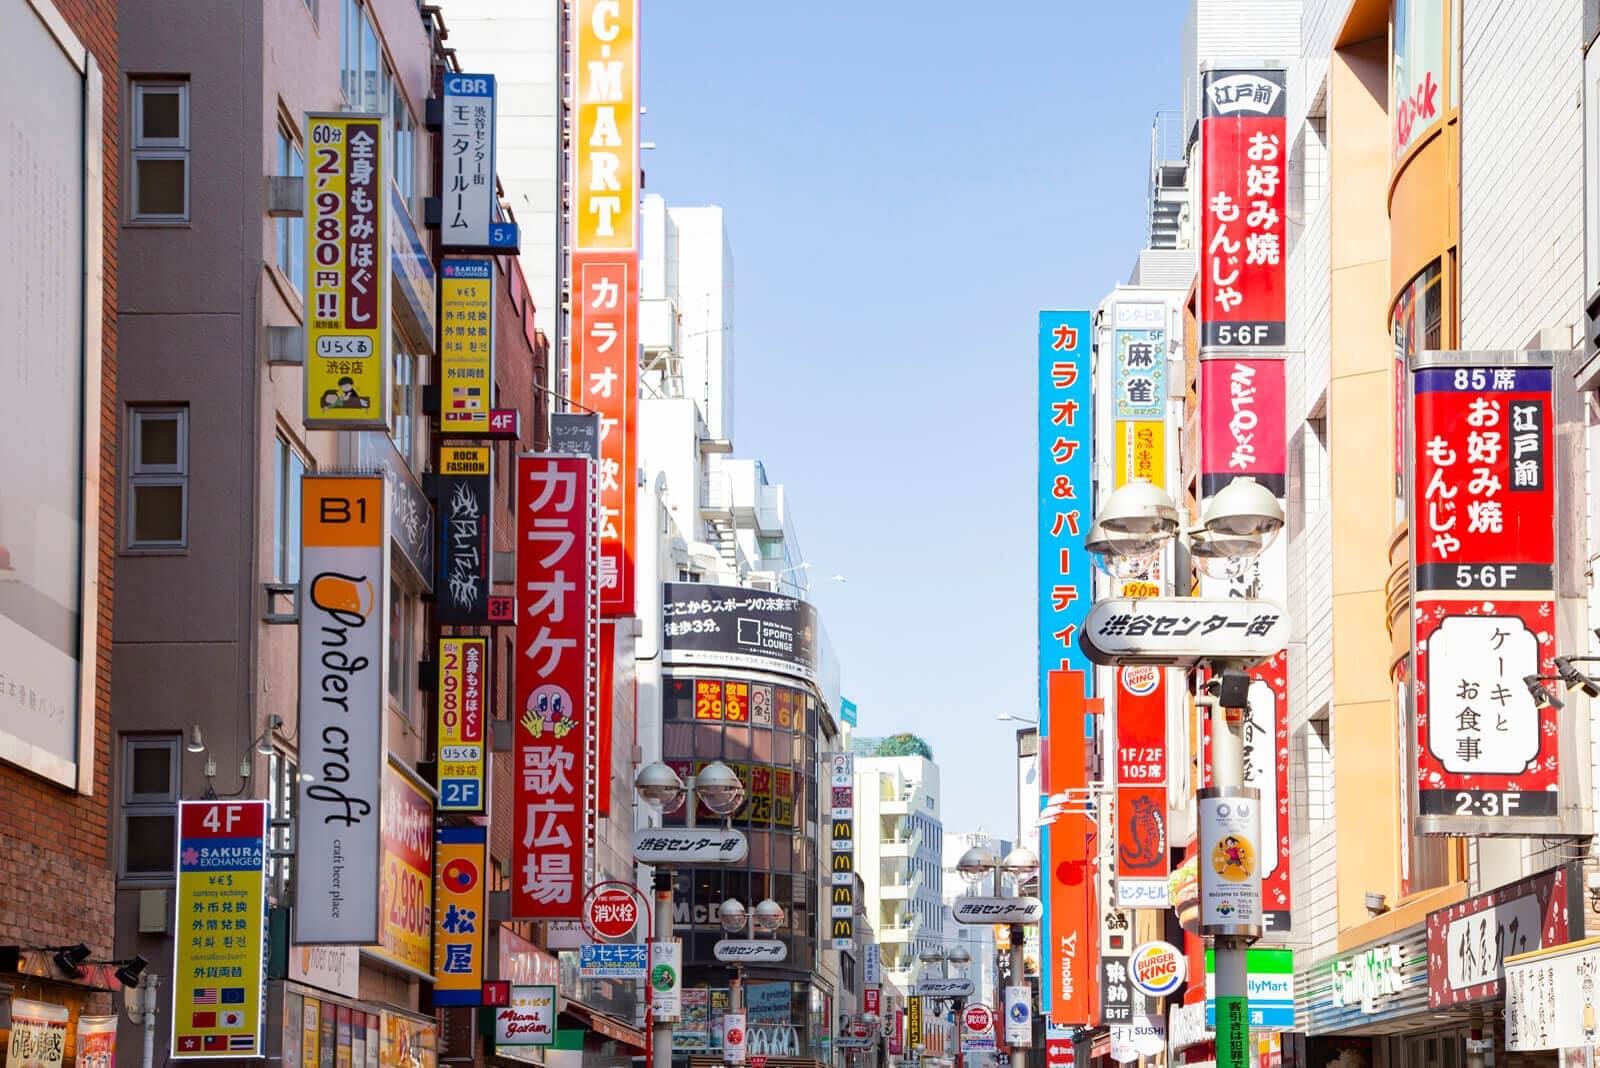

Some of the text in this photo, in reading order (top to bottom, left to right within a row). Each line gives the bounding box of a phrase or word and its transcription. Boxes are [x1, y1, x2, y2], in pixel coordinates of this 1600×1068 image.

[449, 78, 488, 94] CBR
[1214, 84, 1272, 105] 江戸前
[312, 125, 342, 144] 60分
[473, 105, 487, 185] 渋谷センター街
[450, 105, 471, 229] モニタールーム
[1246, 130, 1280, 265] お好み焼
[349, 130, 376, 323] 全身もみほぐし
[1208, 191, 1243, 312] もんじゃ
[1150, 332, 1163, 340] 5F
[320, 339, 368, 354] りらくる
[326, 360, 363, 375] 渋谷店
[1128, 342, 1152, 402] 麻雀
[1454, 368, 1516, 391] 85席
[491, 414, 513, 429] 4F
[1513, 406, 1539, 487] 江戸前
[453, 451, 478, 460] ROCK
[446, 462, 484, 472] FASHION
[1466, 397, 1503, 534] お好み焼
[1425, 435, 1461, 558] もんじゃ
[319, 498, 366, 524] B1
[1122, 584, 1160, 598] 190円
[491, 601, 510, 617] 3F
[1099, 614, 1280, 637] 渋谷センター街
[763, 628, 792, 642] SPORTS
[763, 640, 792, 652] LOUNGE
[1129, 672, 1154, 686] KING
[1490, 627, 1512, 732] ケーキと
[466, 648, 480, 738] 全身もみほぐし
[1456, 679, 1482, 762] お食事
[443, 748, 478, 760] りらくる
[443, 766, 478, 776] 渋谷店
[1122, 765, 1161, 778] 105席
[447, 784, 475, 802] 2F
[202, 806, 242, 833] 4F
[201, 848, 262, 858] SAKURA
[637, 838, 740, 852] 渋谷センター街
[208, 875, 233, 886] ¥€$
[328, 839, 345, 918] craft beer place
[1120, 886, 1166, 899] センタービル
[594, 904, 634, 923] 消火栓
[960, 904, 1037, 914] 渋谷センター街
[442, 904, 476, 974] 松屋
[718, 946, 782, 956] 渋谷センター街
[1138, 952, 1175, 970] BURGER
[1139, 962, 1177, 982] KING
[498, 1010, 540, 1022] Miami
[1106, 1010, 1129, 1019] B1F
[1112, 1026, 1134, 1042] すし
[1134, 1027, 1164, 1036] SUSHI
